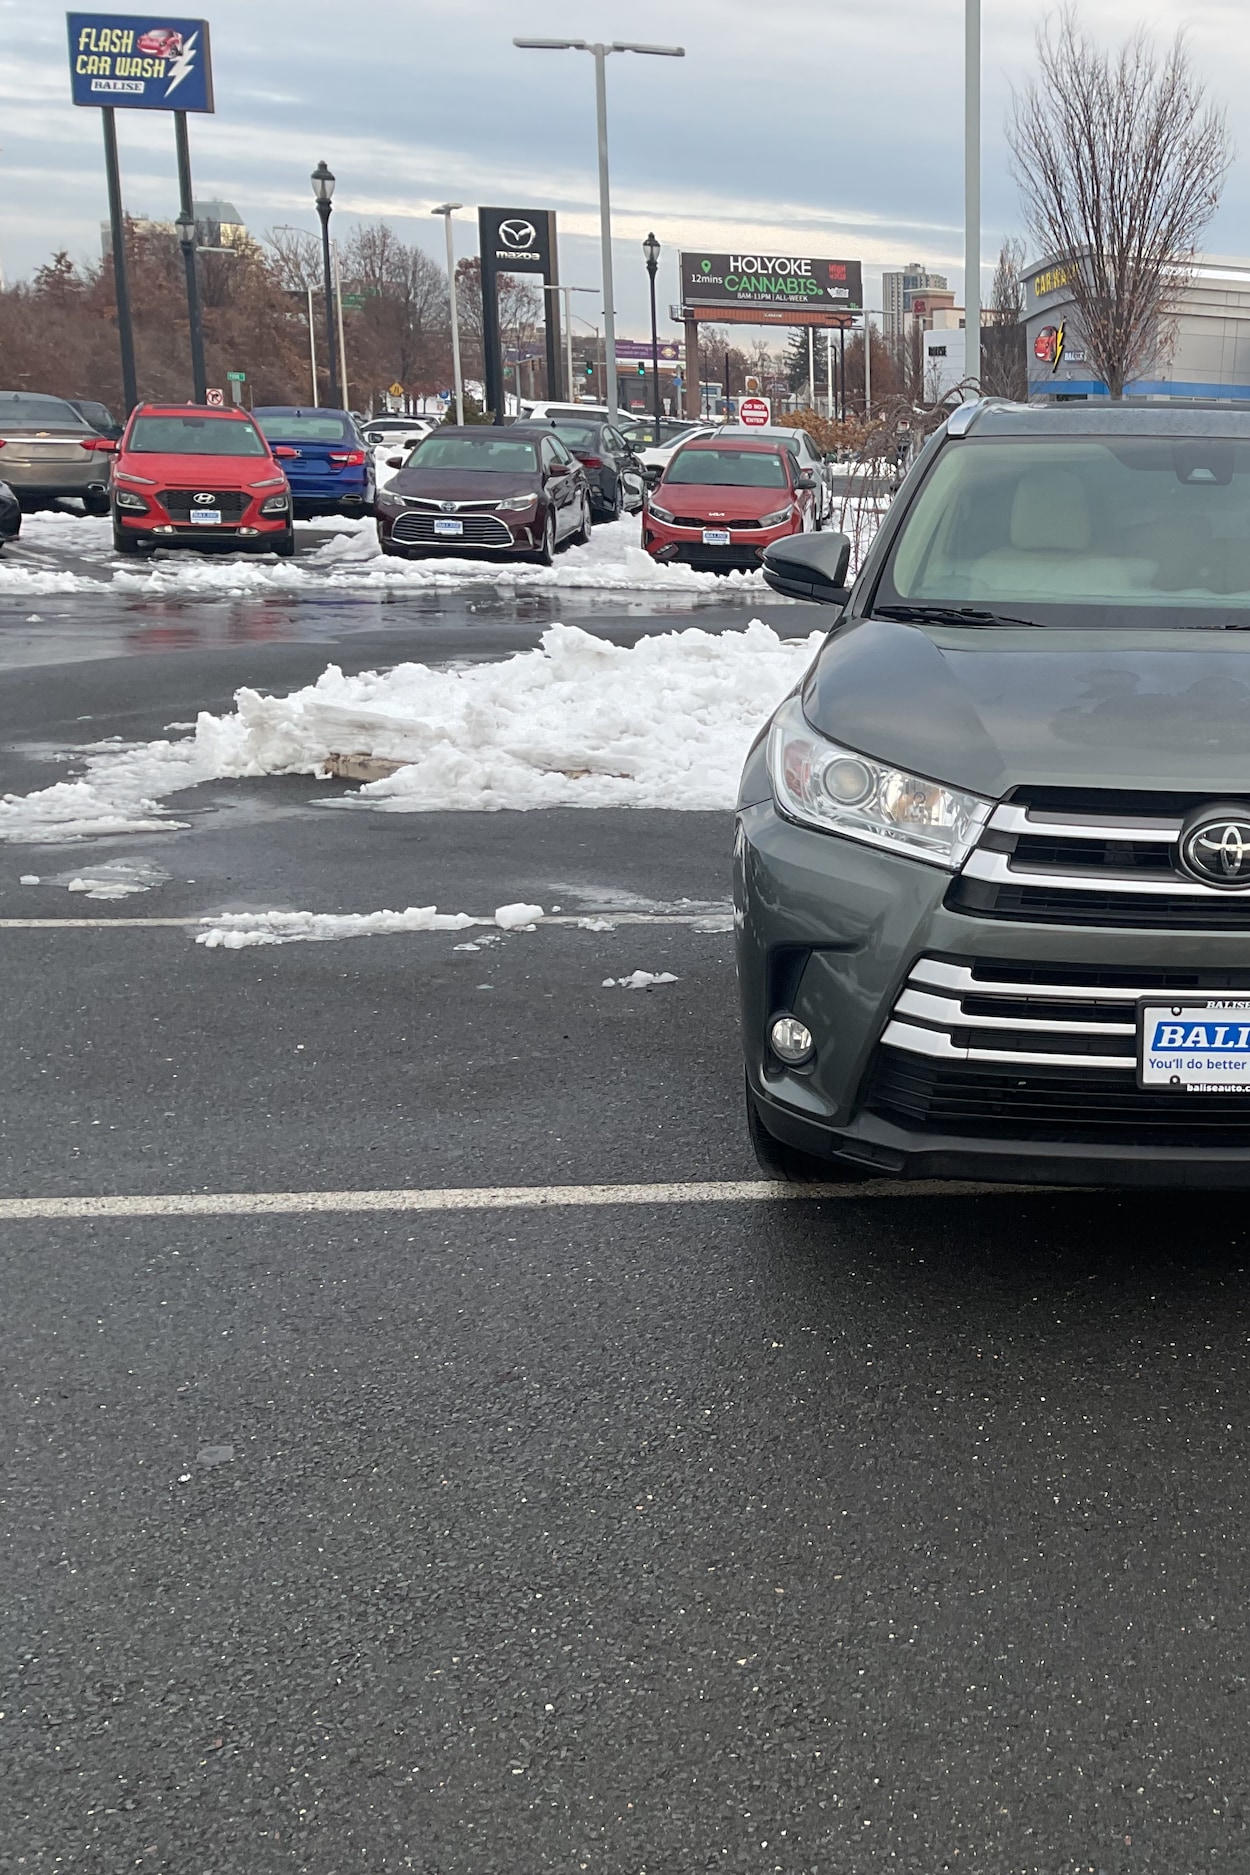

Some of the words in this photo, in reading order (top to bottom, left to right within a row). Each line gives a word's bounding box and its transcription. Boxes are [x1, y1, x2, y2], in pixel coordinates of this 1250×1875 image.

[78, 27, 134, 53] FLASH
[76, 55, 111, 75] CAR
[115, 57, 165, 78] WASH
[93, 80, 143, 91] BALISE
[495, 250, 540, 260] mazda
[730, 255, 812, 276] HOLYOKE
[691, 274, 723, 284] 12mins
[1035, 272, 1052, 297] CAR
[745, 416, 765, 424] ENTER
[1149, 1058, 1183, 1070] You'll
[1186, 1059, 1203, 1070] do
[1207, 1059, 1248, 1071] better
